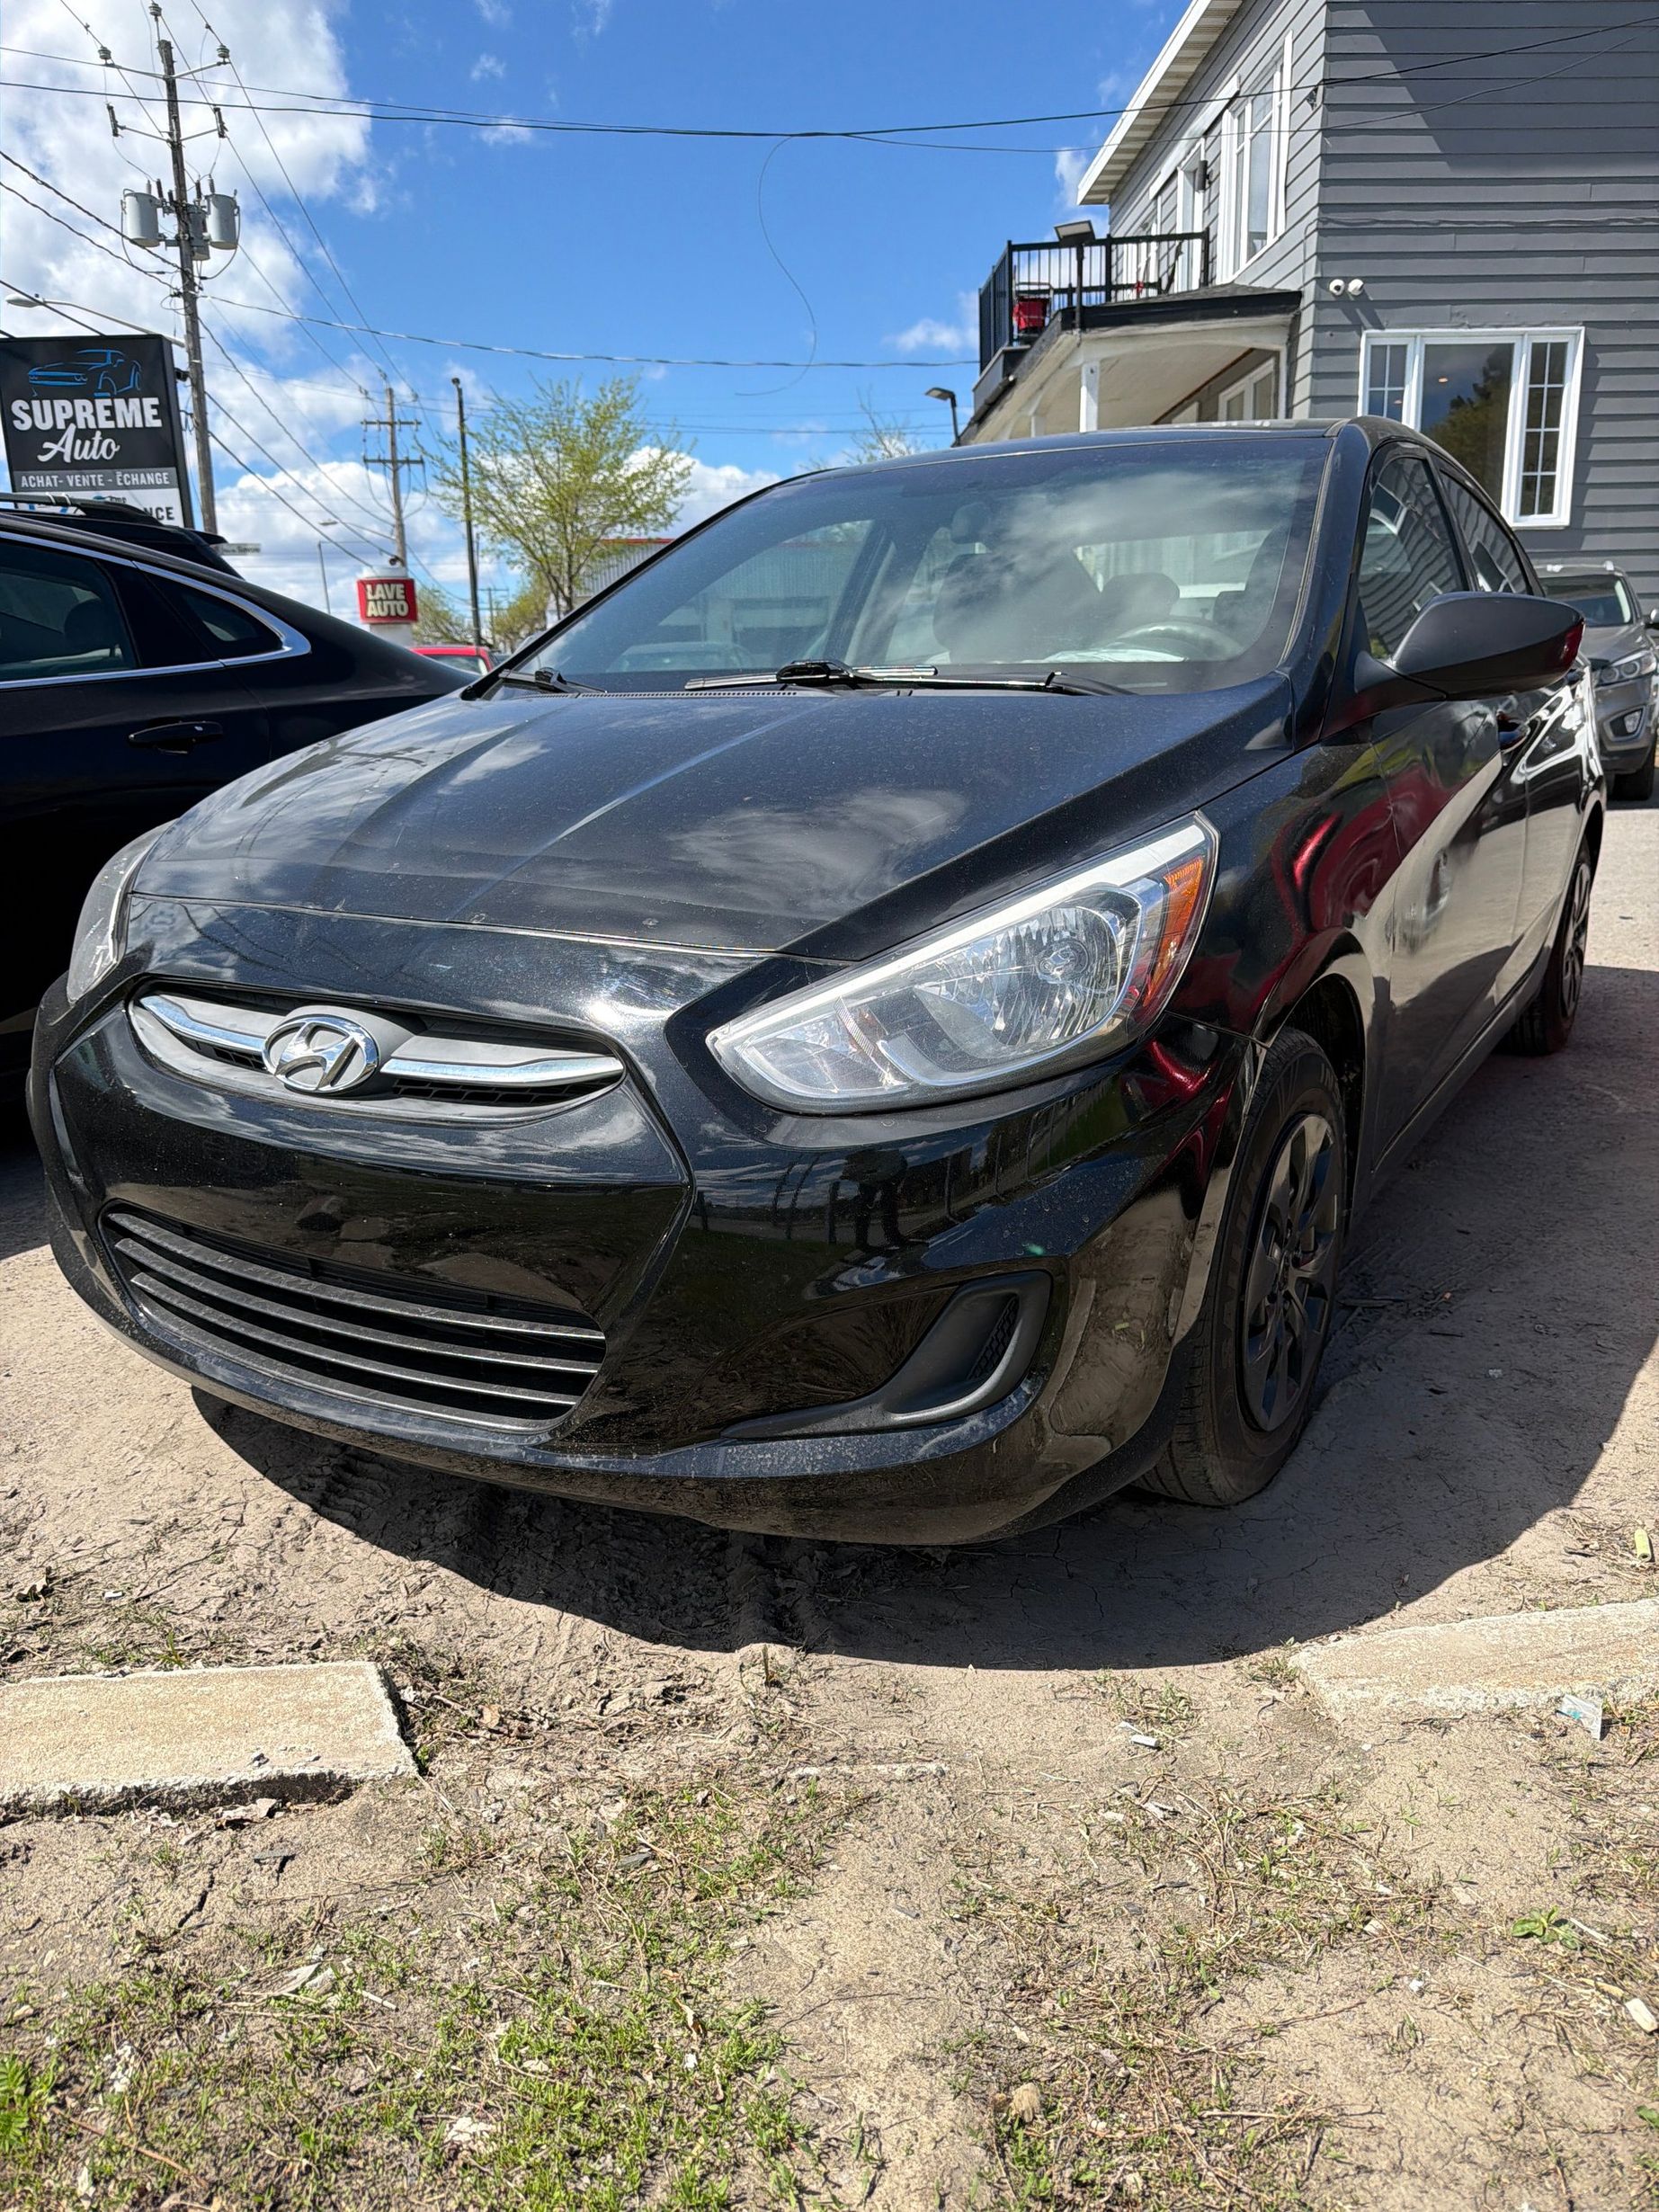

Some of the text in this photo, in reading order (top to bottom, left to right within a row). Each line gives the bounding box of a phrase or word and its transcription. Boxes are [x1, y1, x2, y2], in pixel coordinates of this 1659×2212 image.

[11, 397, 162, 431] SUPREME
[37, 423, 120, 463] Auto
[67, 474, 105, 486] VENTE
[366, 584, 406, 600] LAVE
[367, 600, 409, 617] AUTO
